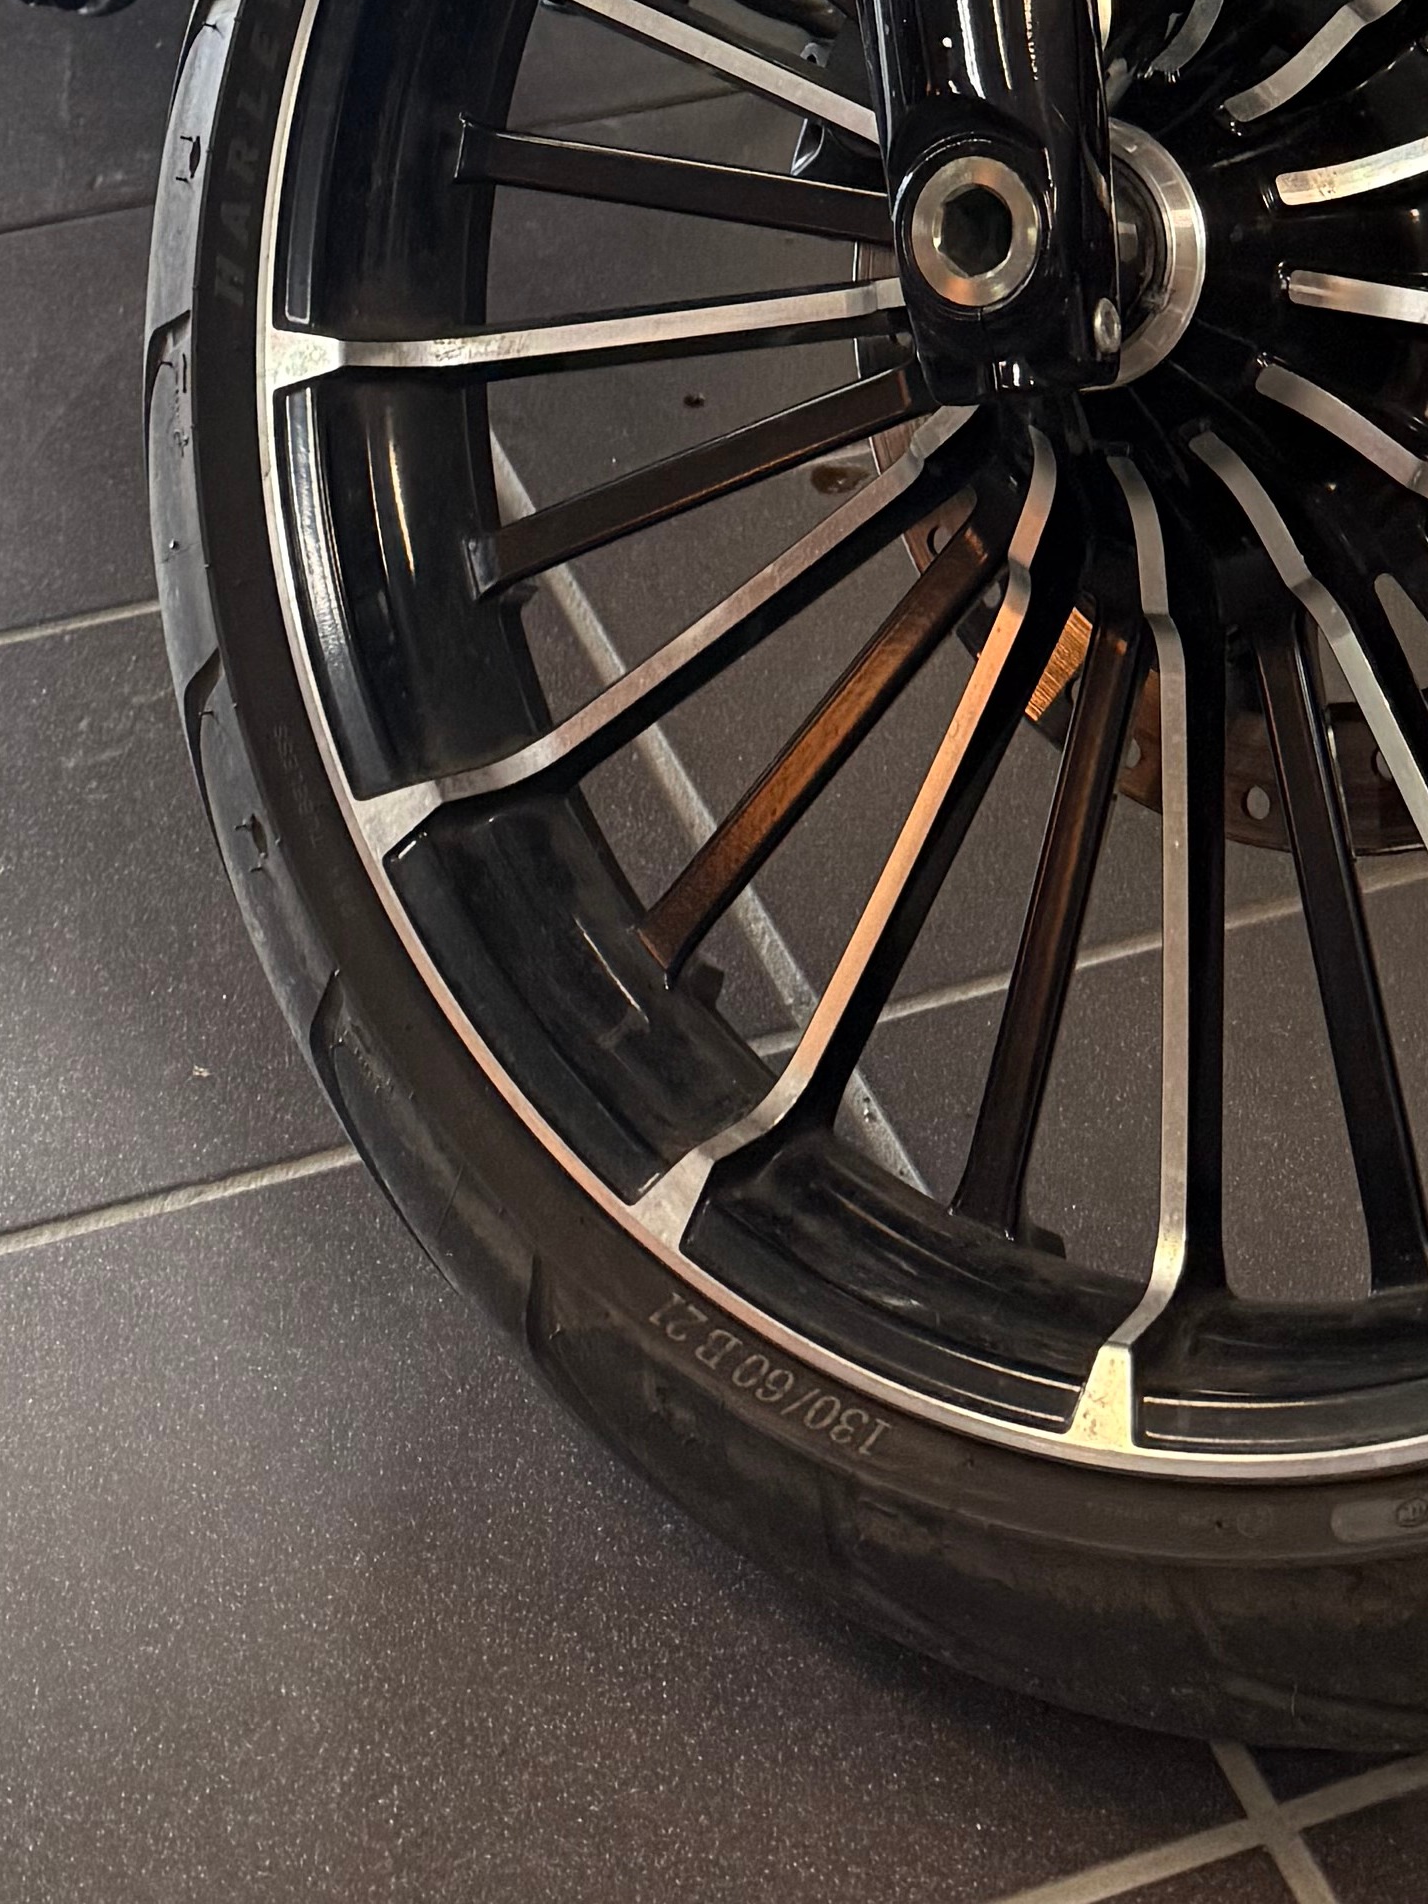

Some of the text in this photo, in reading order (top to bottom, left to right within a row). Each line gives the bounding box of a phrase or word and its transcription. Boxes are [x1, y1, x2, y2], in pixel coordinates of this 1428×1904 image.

[648, 1291, 892, 1456] 130/60 B 21
